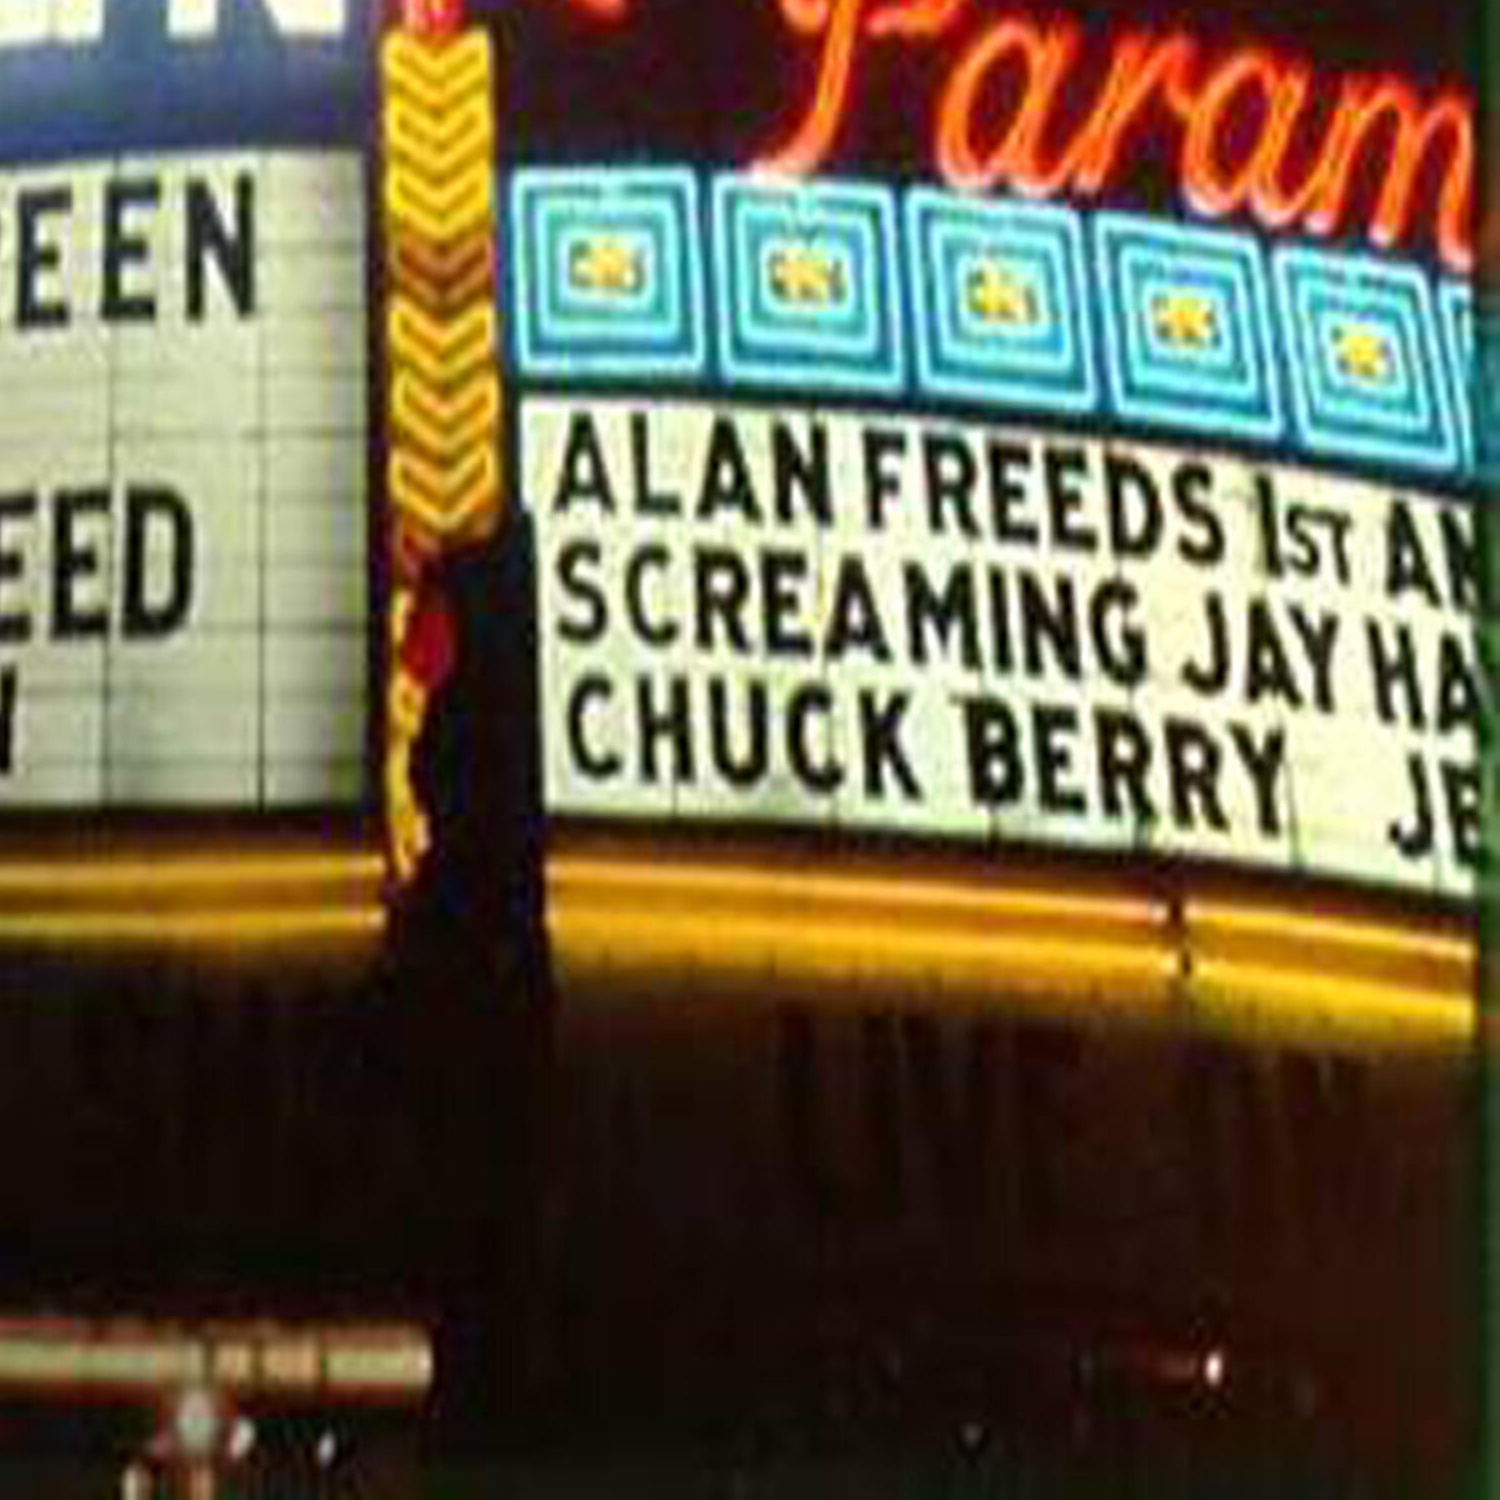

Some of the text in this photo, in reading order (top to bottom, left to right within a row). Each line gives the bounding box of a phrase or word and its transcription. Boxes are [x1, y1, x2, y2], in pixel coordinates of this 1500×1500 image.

[554, 415, 831, 528] ALAN
[862, 428, 1228, 567] FREEDS
[554, 540, 1479, 736] SCREAMING JAY HA
[567, 672, 923, 804] CHUCK
[955, 697, 1286, 839] BERRY
